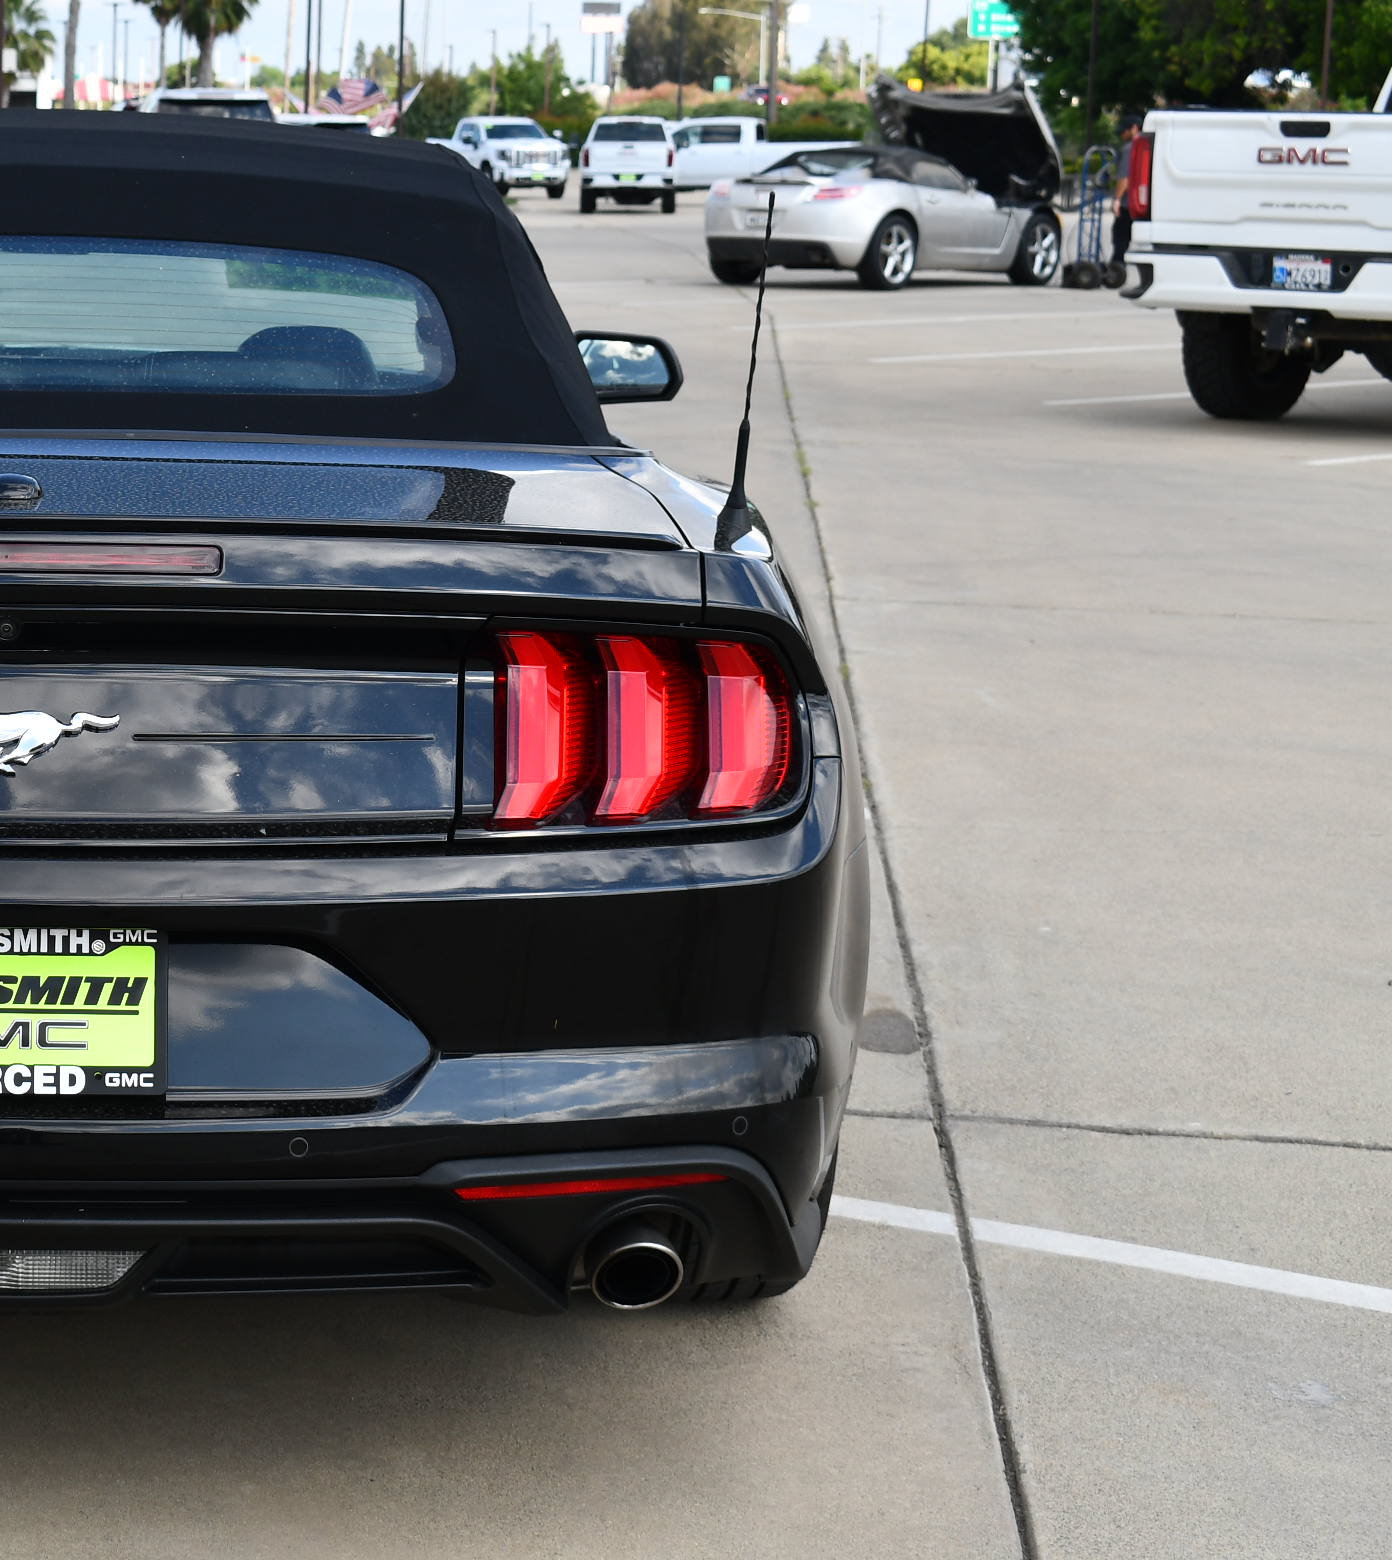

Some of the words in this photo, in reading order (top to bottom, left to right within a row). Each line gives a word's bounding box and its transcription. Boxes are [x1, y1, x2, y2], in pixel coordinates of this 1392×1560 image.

[1257, 147, 1350, 165] GMC
[109, 929, 158, 943] GMC
[104, 1072, 154, 1088] GMC
